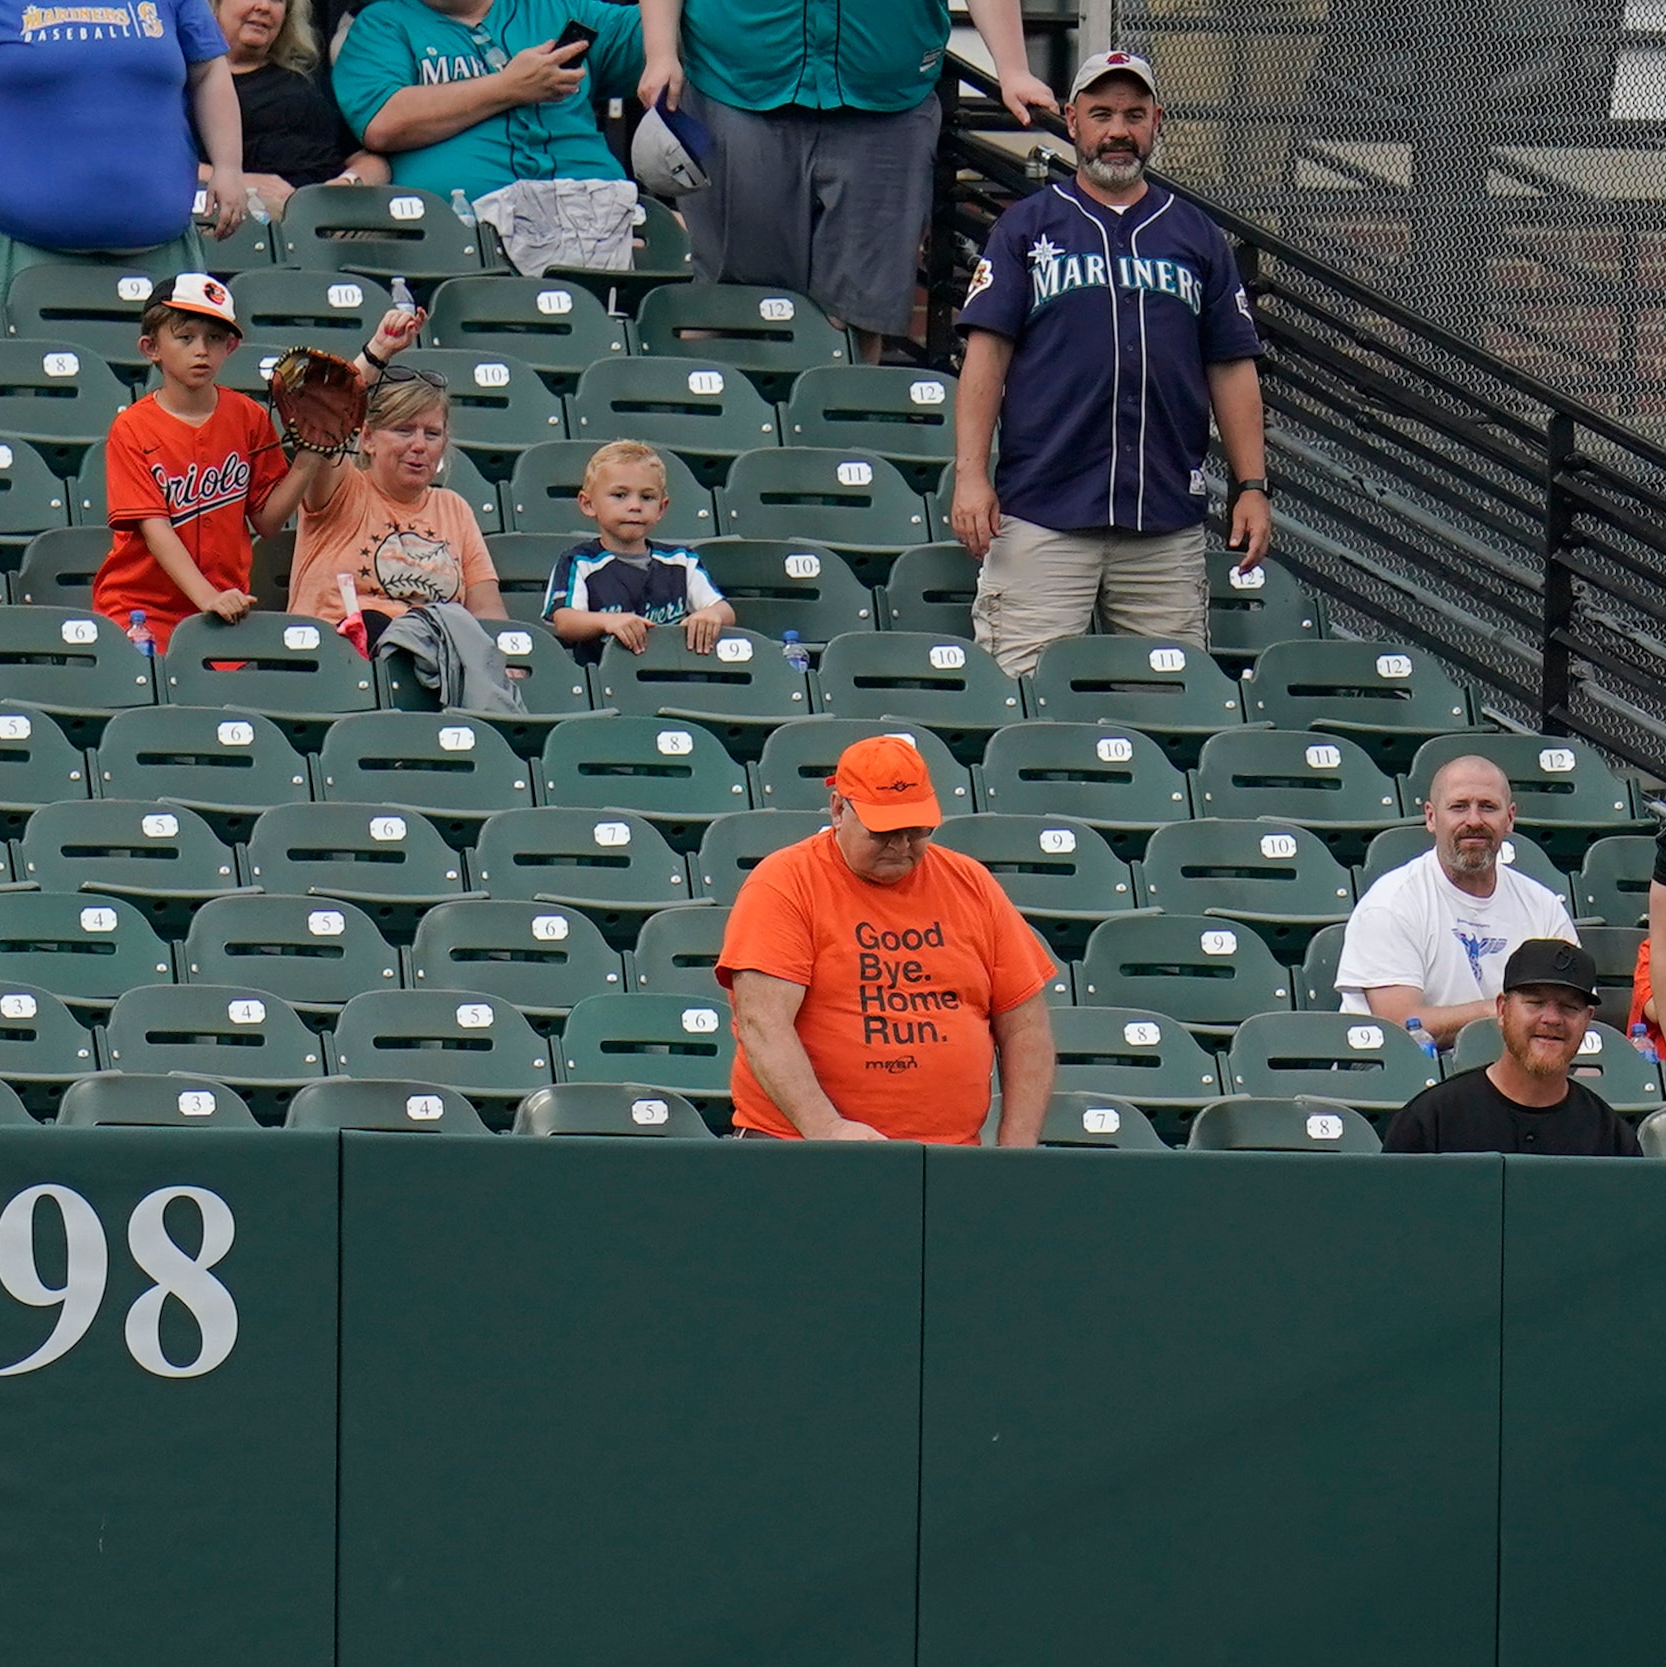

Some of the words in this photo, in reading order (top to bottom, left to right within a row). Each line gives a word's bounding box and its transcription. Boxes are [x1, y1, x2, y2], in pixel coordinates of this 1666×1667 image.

[24, 25, 131, 43] BASEBALL
[398, 200, 415, 215] 11
[130, 282, 140, 296] 9
[1030, 253, 1203, 316] MARINERS
[338, 288, 355, 303] 10
[546, 295, 563, 310] 11
[769, 302, 784, 317] 12
[56, 357, 66, 372] 8
[484, 367, 502, 382] 10
[698, 375, 714, 390] 11
[920, 385, 935, 400] 12
[847, 466, 863, 481] 11
[795, 558, 813, 573] 10
[75, 624, 85, 639] 6
[296, 630, 306, 645] 7
[510, 636, 520, 651] 8
[729, 642, 740, 657] 9
[939, 649, 957, 664] 10
[1159, 652, 1175, 667] 11
[1386, 659, 1402, 674] 12
[9, 720, 18, 735] 5
[231, 726, 241, 741] 6
[451, 731, 461, 746] 7
[670, 736, 680, 751] 8
[1107, 742, 1125, 757] 10
[1315, 749, 1331, 764] 11
[1549, 753, 1565, 768] 12
[155, 818, 165, 833] 5
[383, 821, 394, 836] 6
[607, 827, 616, 842] 7
[1052, 833, 1063, 848] 9
[1271, 839, 1289, 853] 10
[93, 912, 103, 927] 4
[322, 915, 331, 931] 5
[545, 920, 556, 935] 6
[855, 921, 945, 951] Good
[1214, 936, 1224, 951] 9
[859, 953, 932, 989] Bye.
[14, 999, 23, 1014] 3
[859, 985, 959, 1013] Home
[242, 1004, 251, 1019] 4
[471, 1008, 480, 1024] 5
[695, 1013, 706, 1027] 6
[863, 1016, 948, 1045] Run.
[1137, 1026, 1147, 1041] 8
[1360, 1030, 1371, 1045] 9
[192, 1095, 202, 1111] 3
[420, 1100, 430, 1115] 4
[646, 1104, 655, 1120] 5
[1096, 1113, 1106, 1129] 7
[1320, 1120, 1330, 1135] 8
